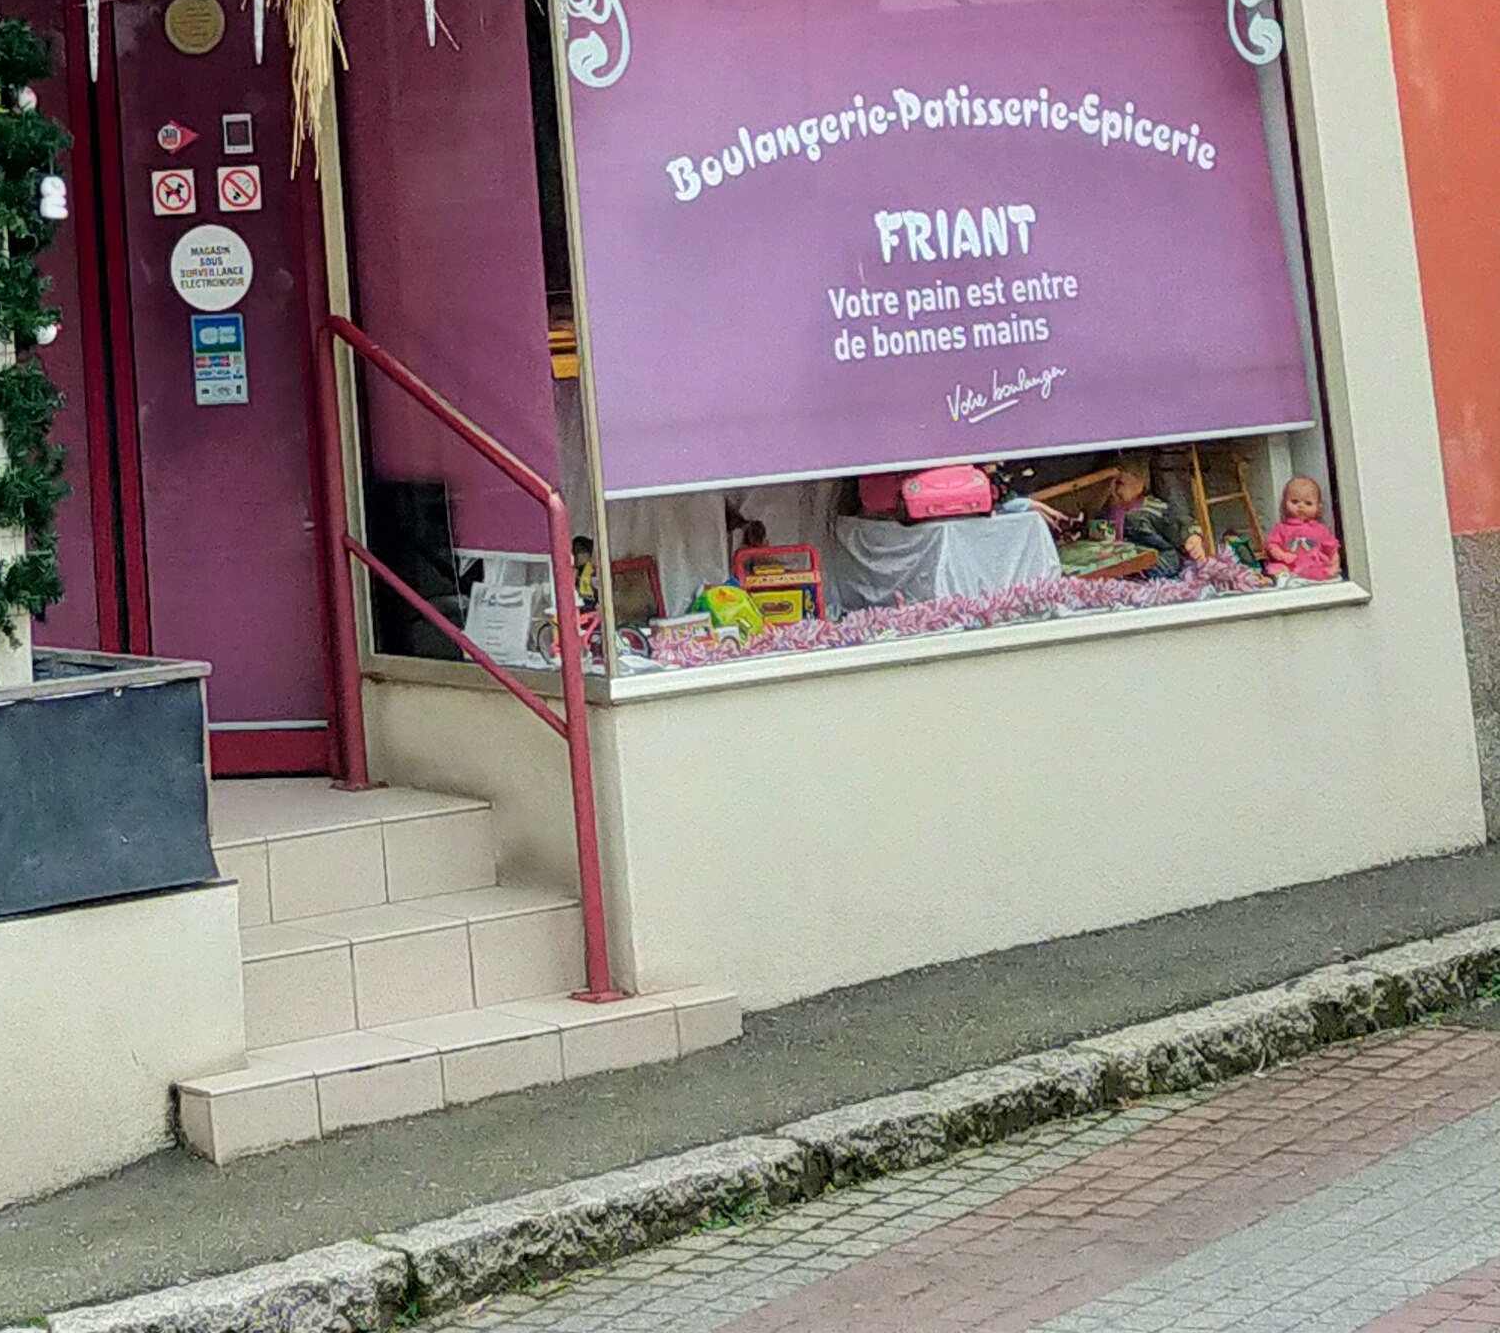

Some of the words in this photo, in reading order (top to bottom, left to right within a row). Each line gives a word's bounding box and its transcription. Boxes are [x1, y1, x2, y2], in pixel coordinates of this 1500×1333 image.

[873, 204, 1037, 264] FRIANT
[190, 245, 231, 256] MAGASIN
[199, 256, 223, 267] SOUS
[179, 266, 245, 279] SURVEILLANCE
[827, 289, 900, 320] Votre
[905, 280, 961, 321] pain
[966, 275, 1006, 309] est
[1011, 271, 1079, 305] entre
[833, 328, 867, 361] de
[873, 323, 967, 358] bonnes
[972, 314, 1050, 345] mains
